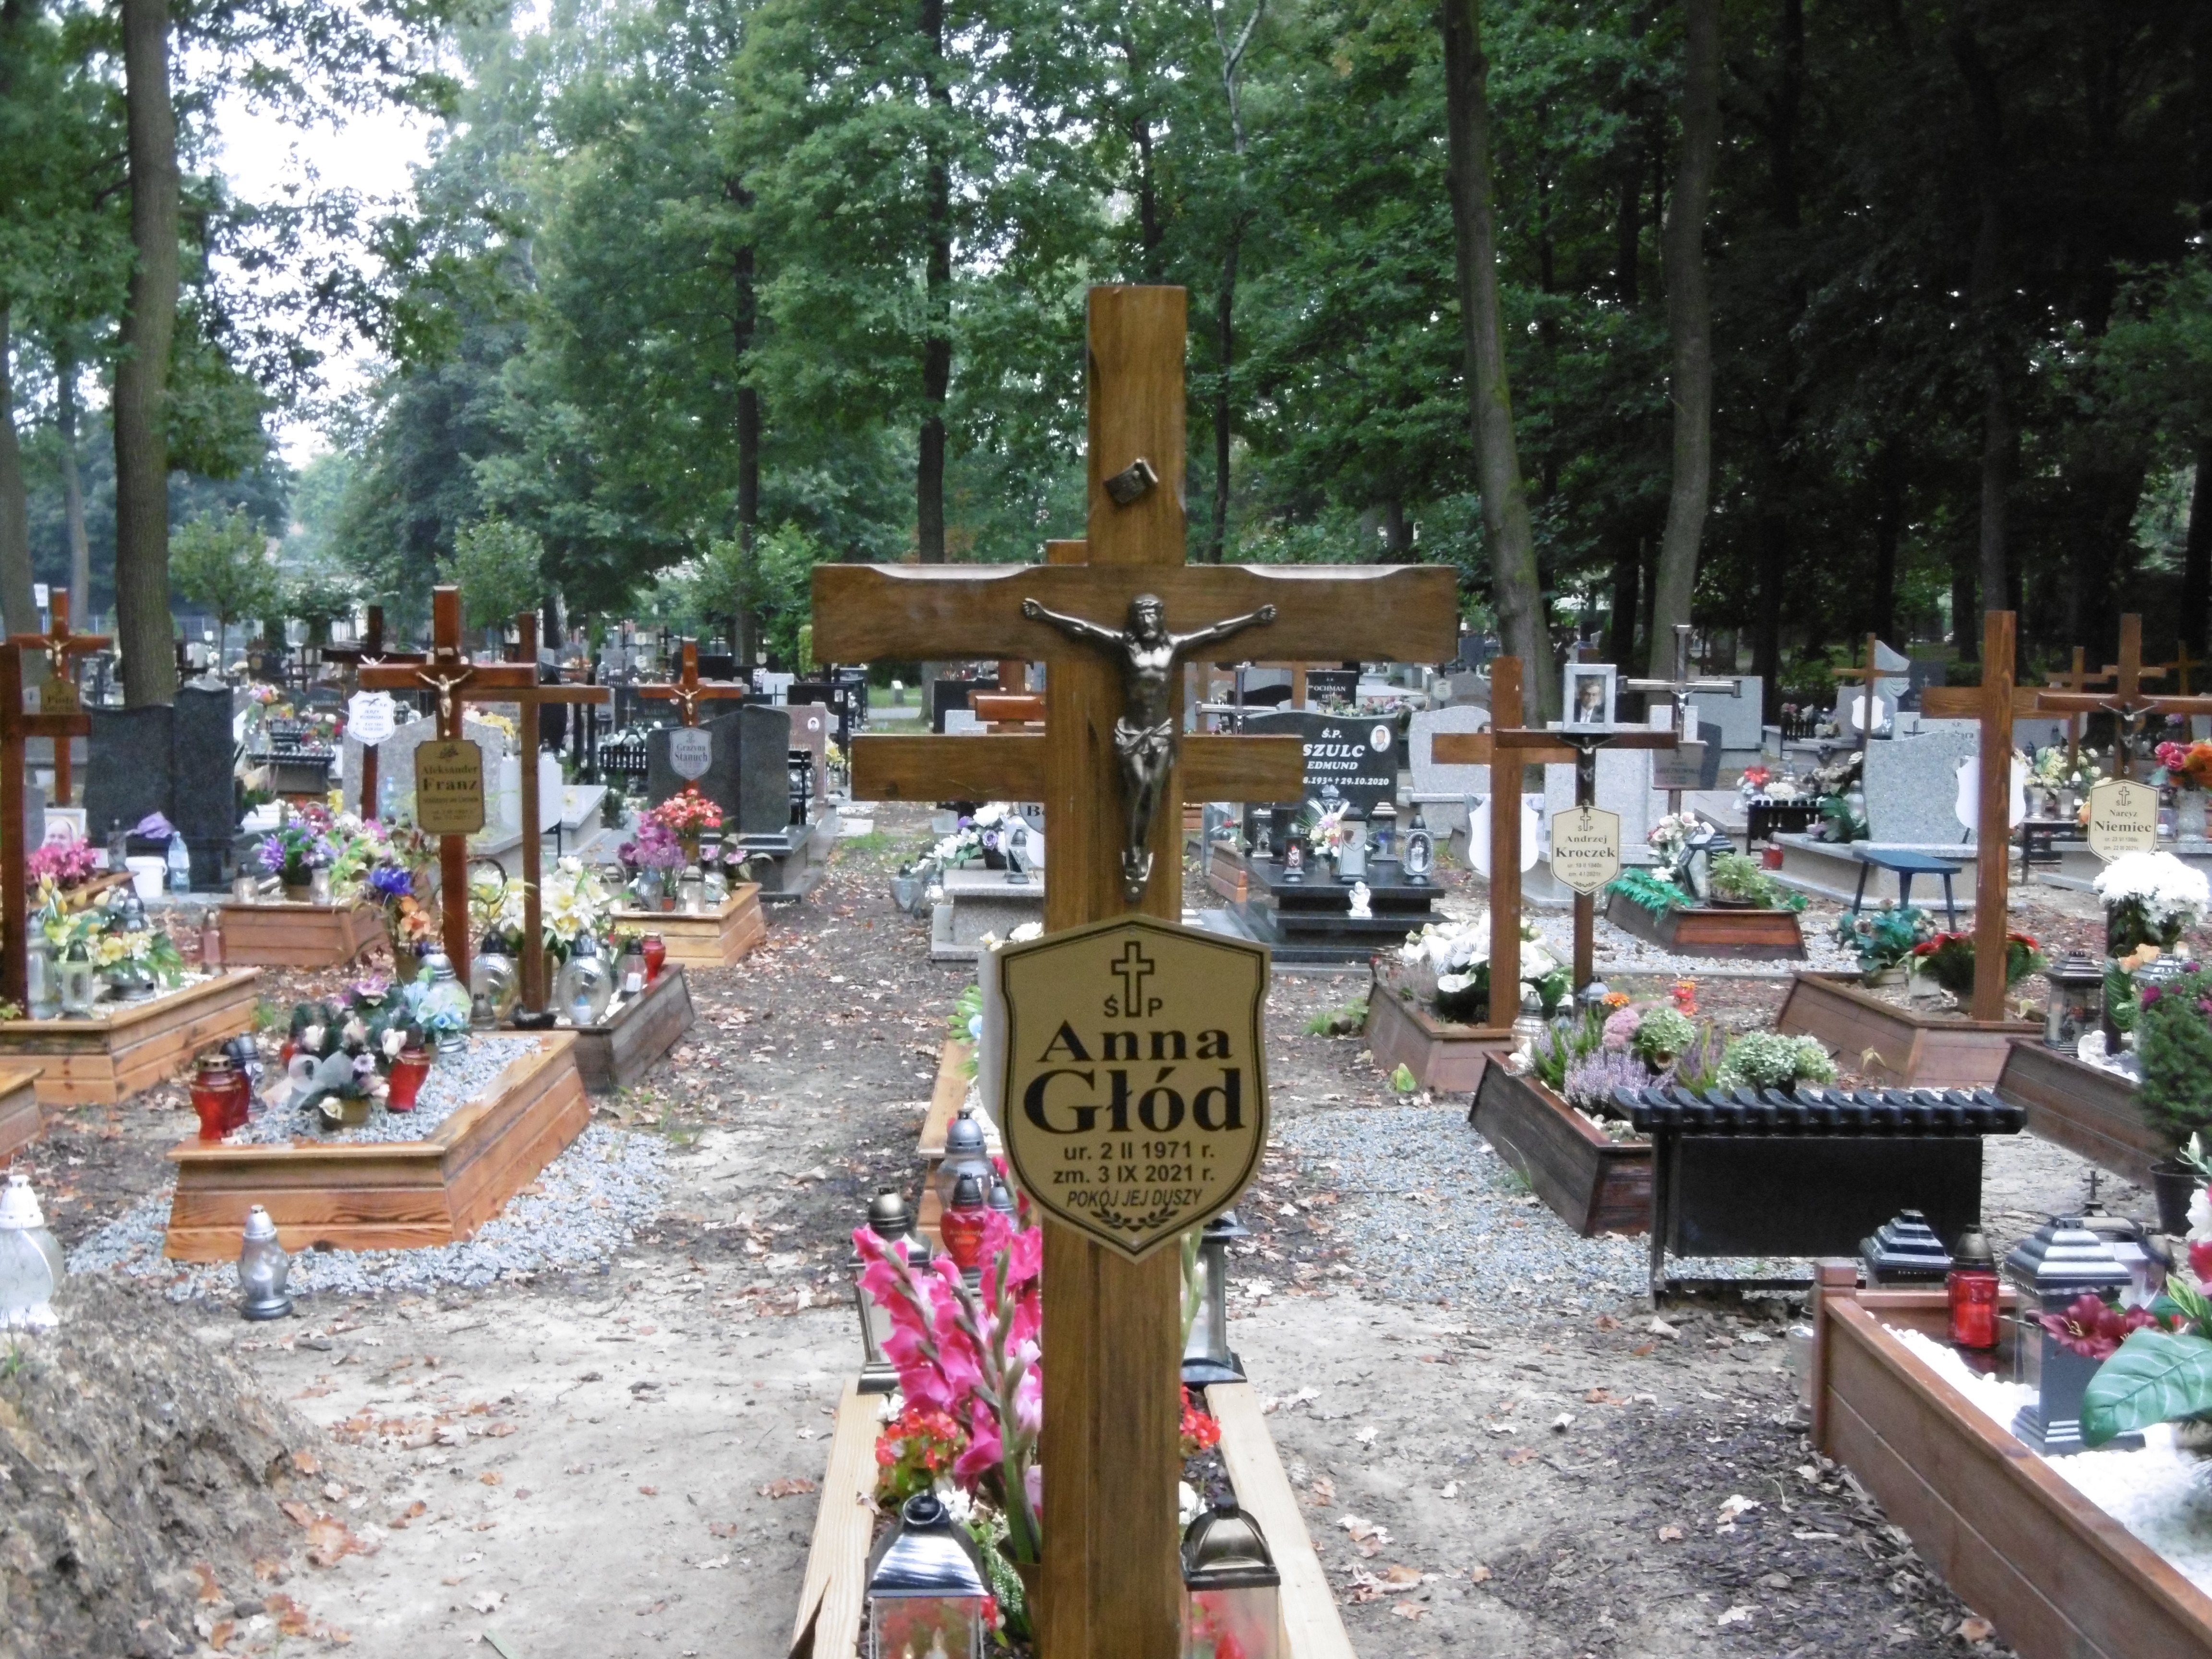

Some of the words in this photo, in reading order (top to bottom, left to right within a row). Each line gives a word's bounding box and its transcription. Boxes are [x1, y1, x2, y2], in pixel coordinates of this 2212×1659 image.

[1321, 727, 1342, 738] Ś.P.
[1303, 744, 1365, 757] SZULC
[424, 765, 477, 774] Aleksander
[1307, 761, 1358, 770] EDMUND
[423, 778, 477, 791] Franz
[1340, 777, 1390, 786] 29.10.2020
[2109, 809, 2138, 819] Narcyz
[2094, 820, 2152, 833] Niemiec
[1565, 835, 1608, 844] Andrzej
[1556, 847, 1616, 858] Kroczek
[1104, 994, 1119, 1018] Ś
[1147, 998, 1163, 1018] P
[1036, 1020, 1233, 1062] Anna
[1023, 1067, 1246, 1135] Głód
[1064, 1146, 1092, 1161] ur.
[1100, 1142, 1113, 1160] 2
[1120, 1142, 1133, 1160] II
[1142, 1141, 1191, 1159] 1971
[1202, 1144, 1214, 1158] r.
[1053, 1170, 1090, 1184] zm.
[1098, 1165, 1110, 1184] 3
[1117, 1165, 1138, 1183] IX
[1145, 1164, 1192, 1183] 2021
[1202, 1168, 1214, 1181] r.
[1066, 1187, 1119, 1208] POKÓJ
[1121, 1189, 1149, 1207] JEJ
[1152, 1188, 1203, 1206] DUSZY
